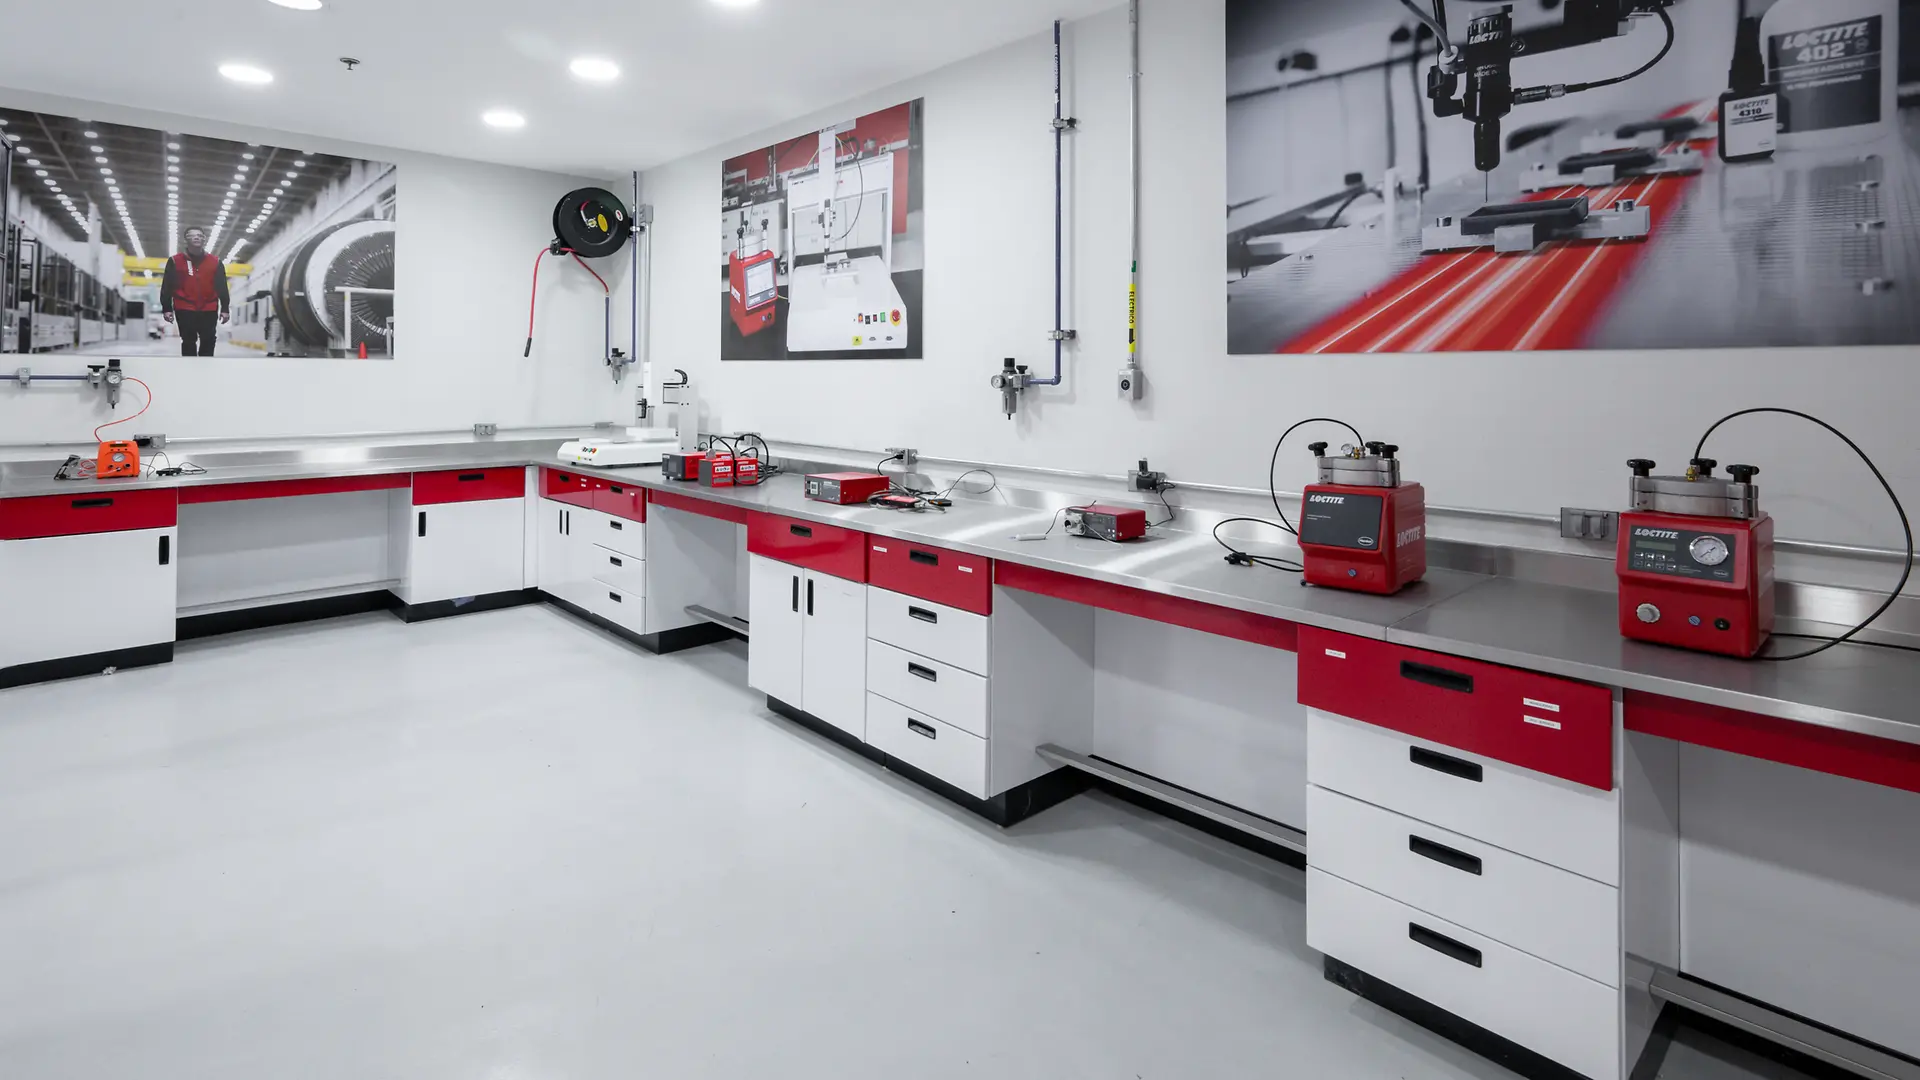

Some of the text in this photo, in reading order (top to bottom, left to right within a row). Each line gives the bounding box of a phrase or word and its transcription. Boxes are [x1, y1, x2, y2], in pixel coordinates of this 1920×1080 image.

[1781, 21, 1868, 50] LOCTITE
[1796, 41, 1845, 62] 402
[1733, 98, 1769, 110] LOCTITE
[1739, 107, 1762, 117] 4310
[1309, 495, 1344, 504] LOCTITE
[1396, 525, 1421, 548] LOCTITE
[1634, 528, 1679, 539] LOCTITE
